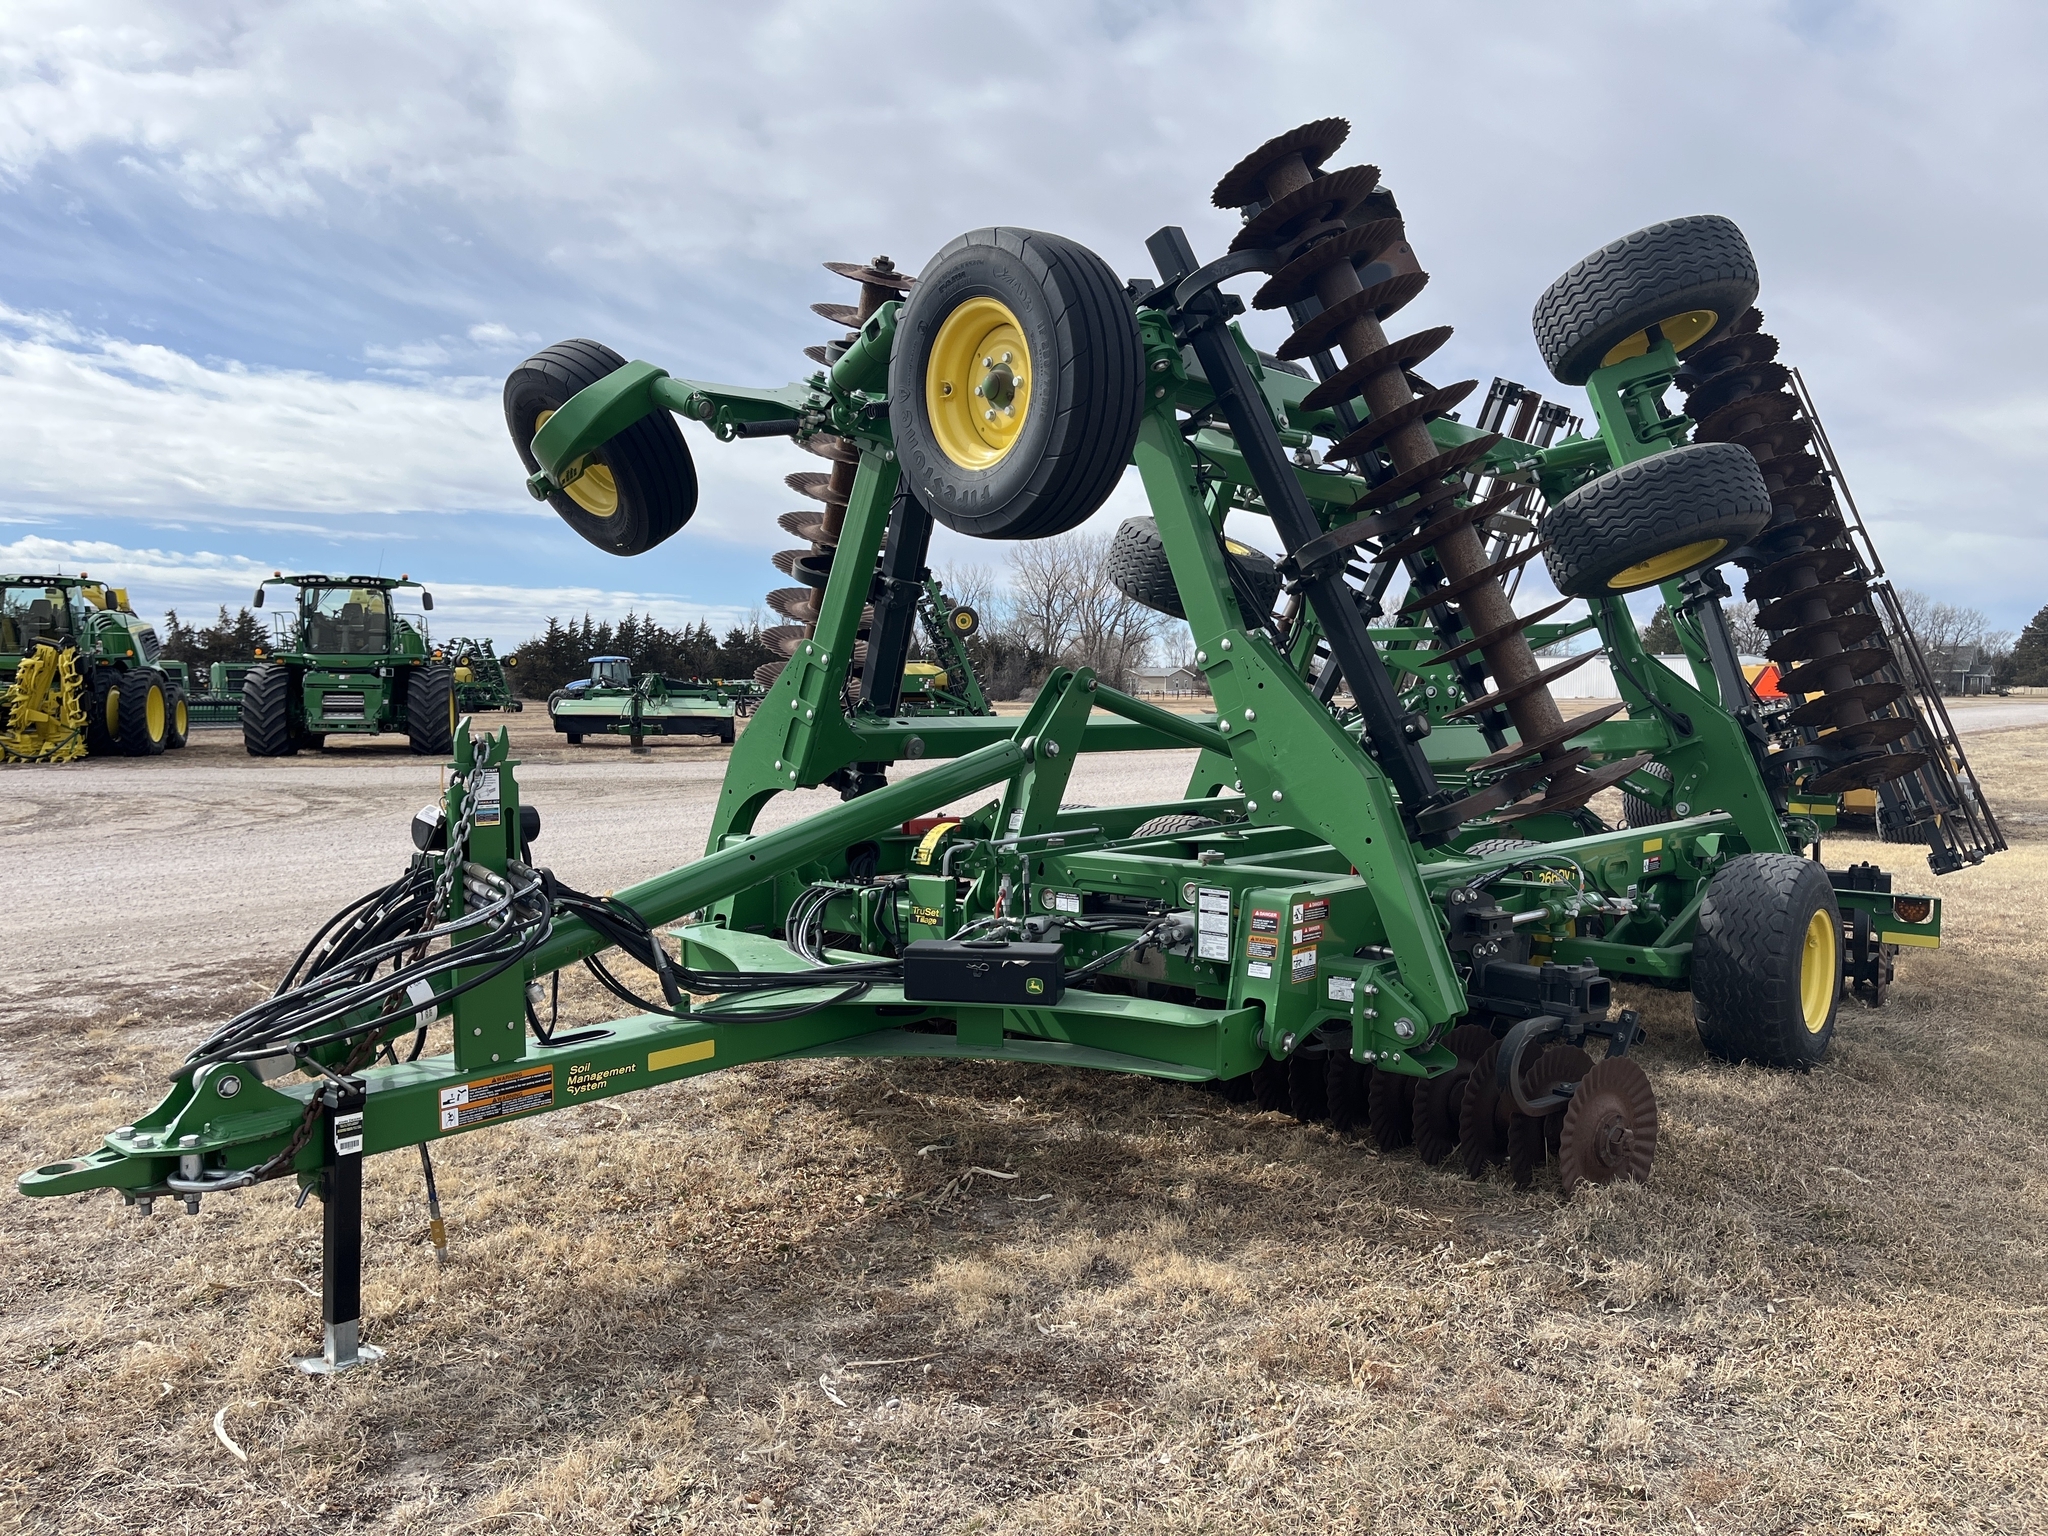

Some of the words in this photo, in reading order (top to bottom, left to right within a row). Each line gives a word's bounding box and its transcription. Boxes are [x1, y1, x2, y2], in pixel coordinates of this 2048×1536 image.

[899, 409, 995, 508] Firestone
[912, 905, 940, 917] TruSet
[915, 914, 937, 926] Tillage
[566, 1063, 637, 1086] Management
[569, 1062, 591, 1075] Soil
[496, 1071, 523, 1083] WARNING
[566, 1080, 608, 1096] System
[497, 1092, 524, 1103] WARNING
